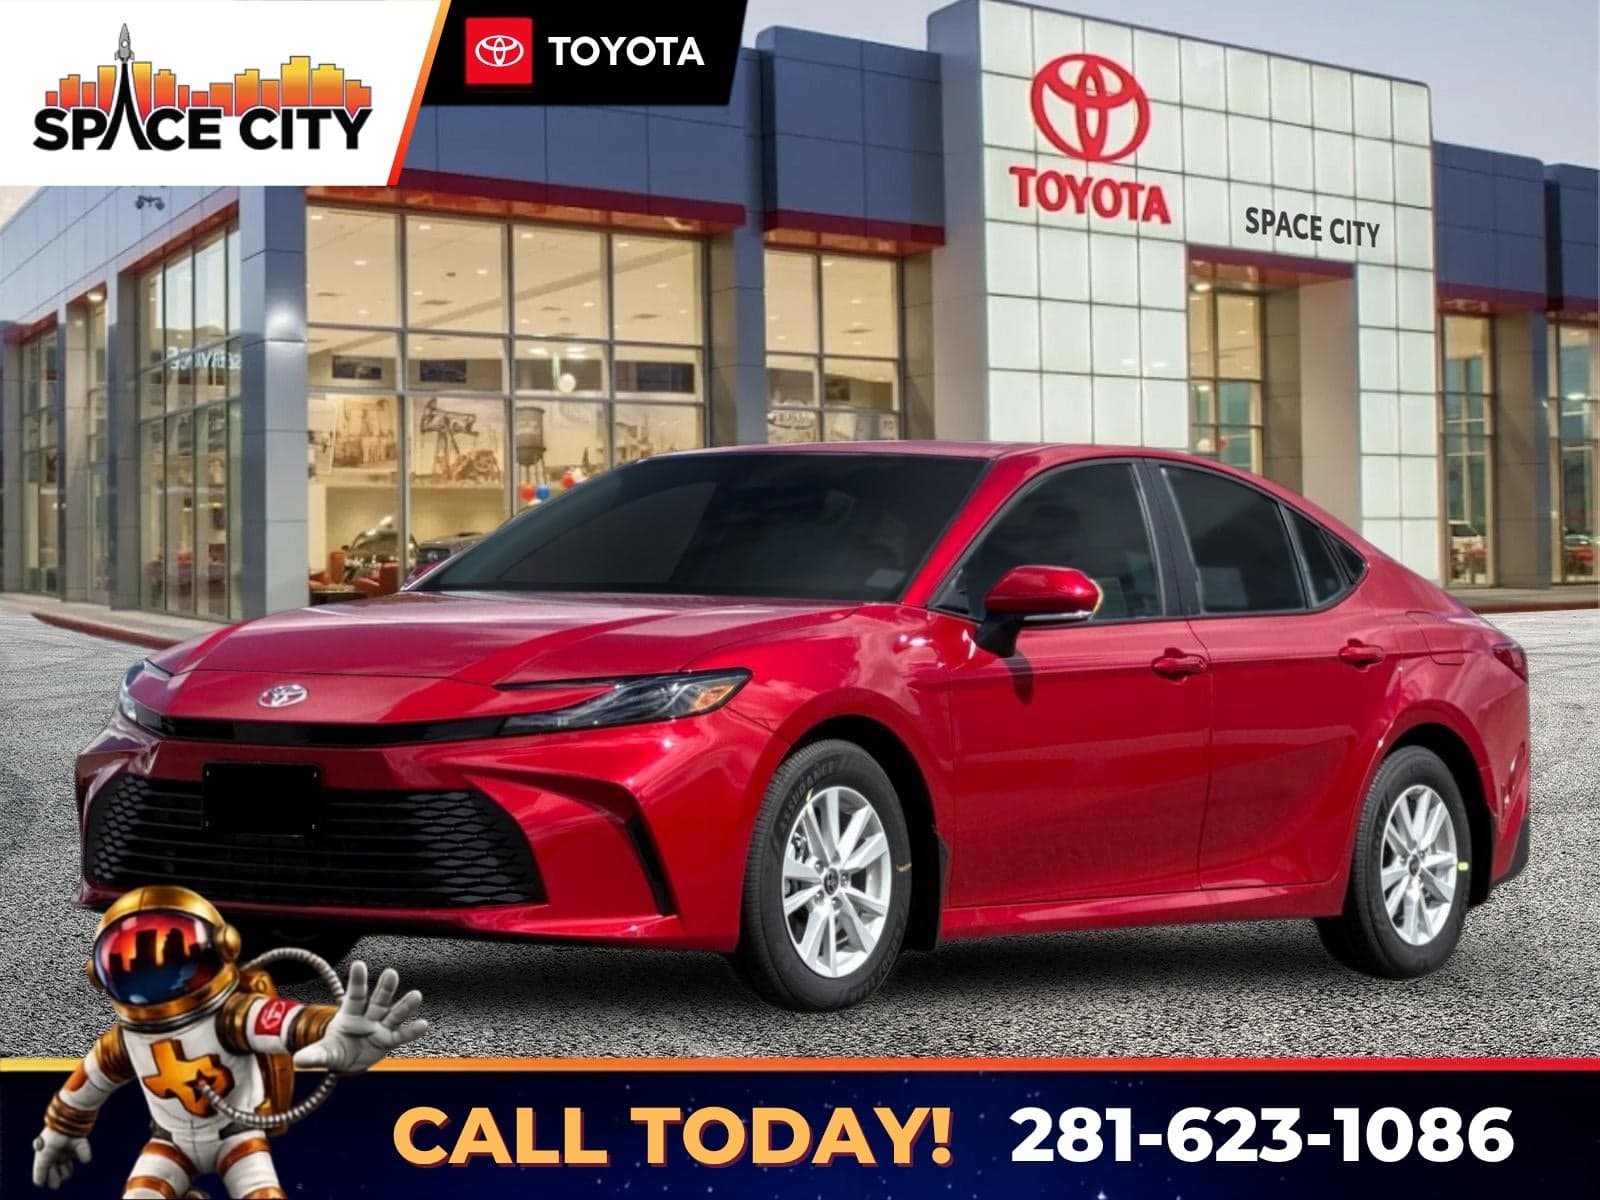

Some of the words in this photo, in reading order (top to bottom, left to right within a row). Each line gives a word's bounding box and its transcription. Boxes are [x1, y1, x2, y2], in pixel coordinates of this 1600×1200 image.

[1009, 166, 1171, 224] TOYOTA
[1245, 206, 1323, 242] SPACE
[1329, 217, 1380, 248] CITY
